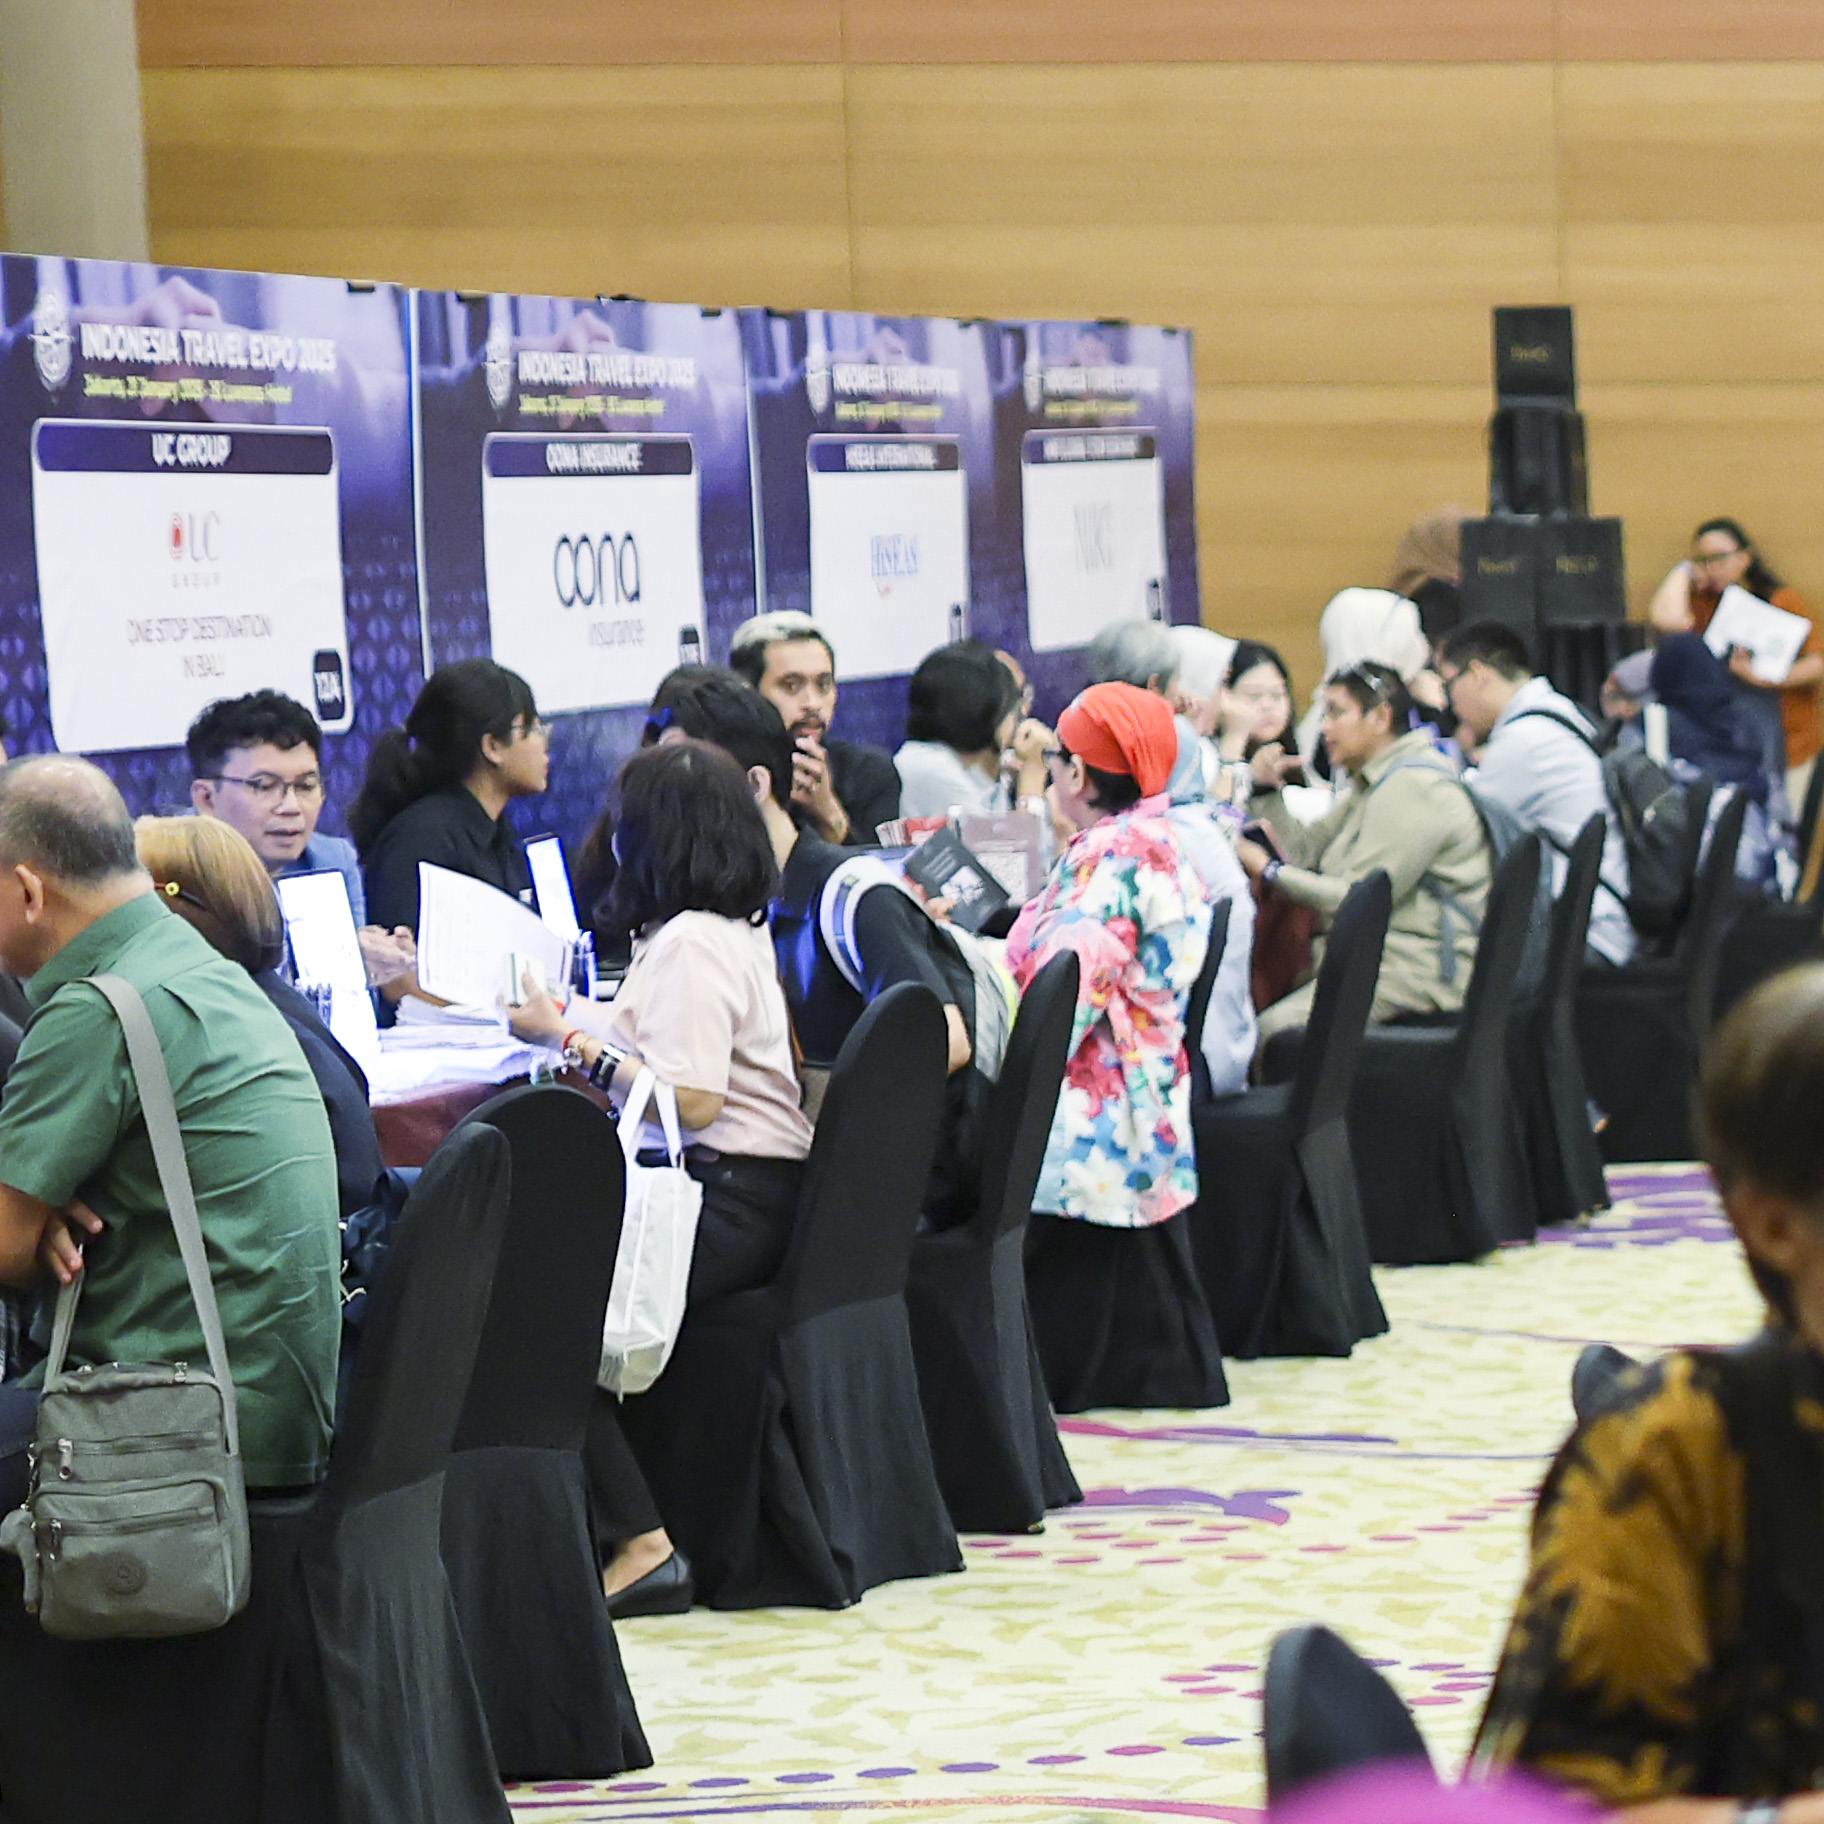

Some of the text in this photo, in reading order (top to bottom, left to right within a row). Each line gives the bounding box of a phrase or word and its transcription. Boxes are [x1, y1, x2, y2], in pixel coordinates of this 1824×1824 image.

[80, 322, 180, 364] INDONESIA
[180, 328, 249, 368] TRAVEL
[250, 334, 296, 372] EXPO
[151, 432, 232, 468] UC GROUP
[553, 530, 641, 609] oona
